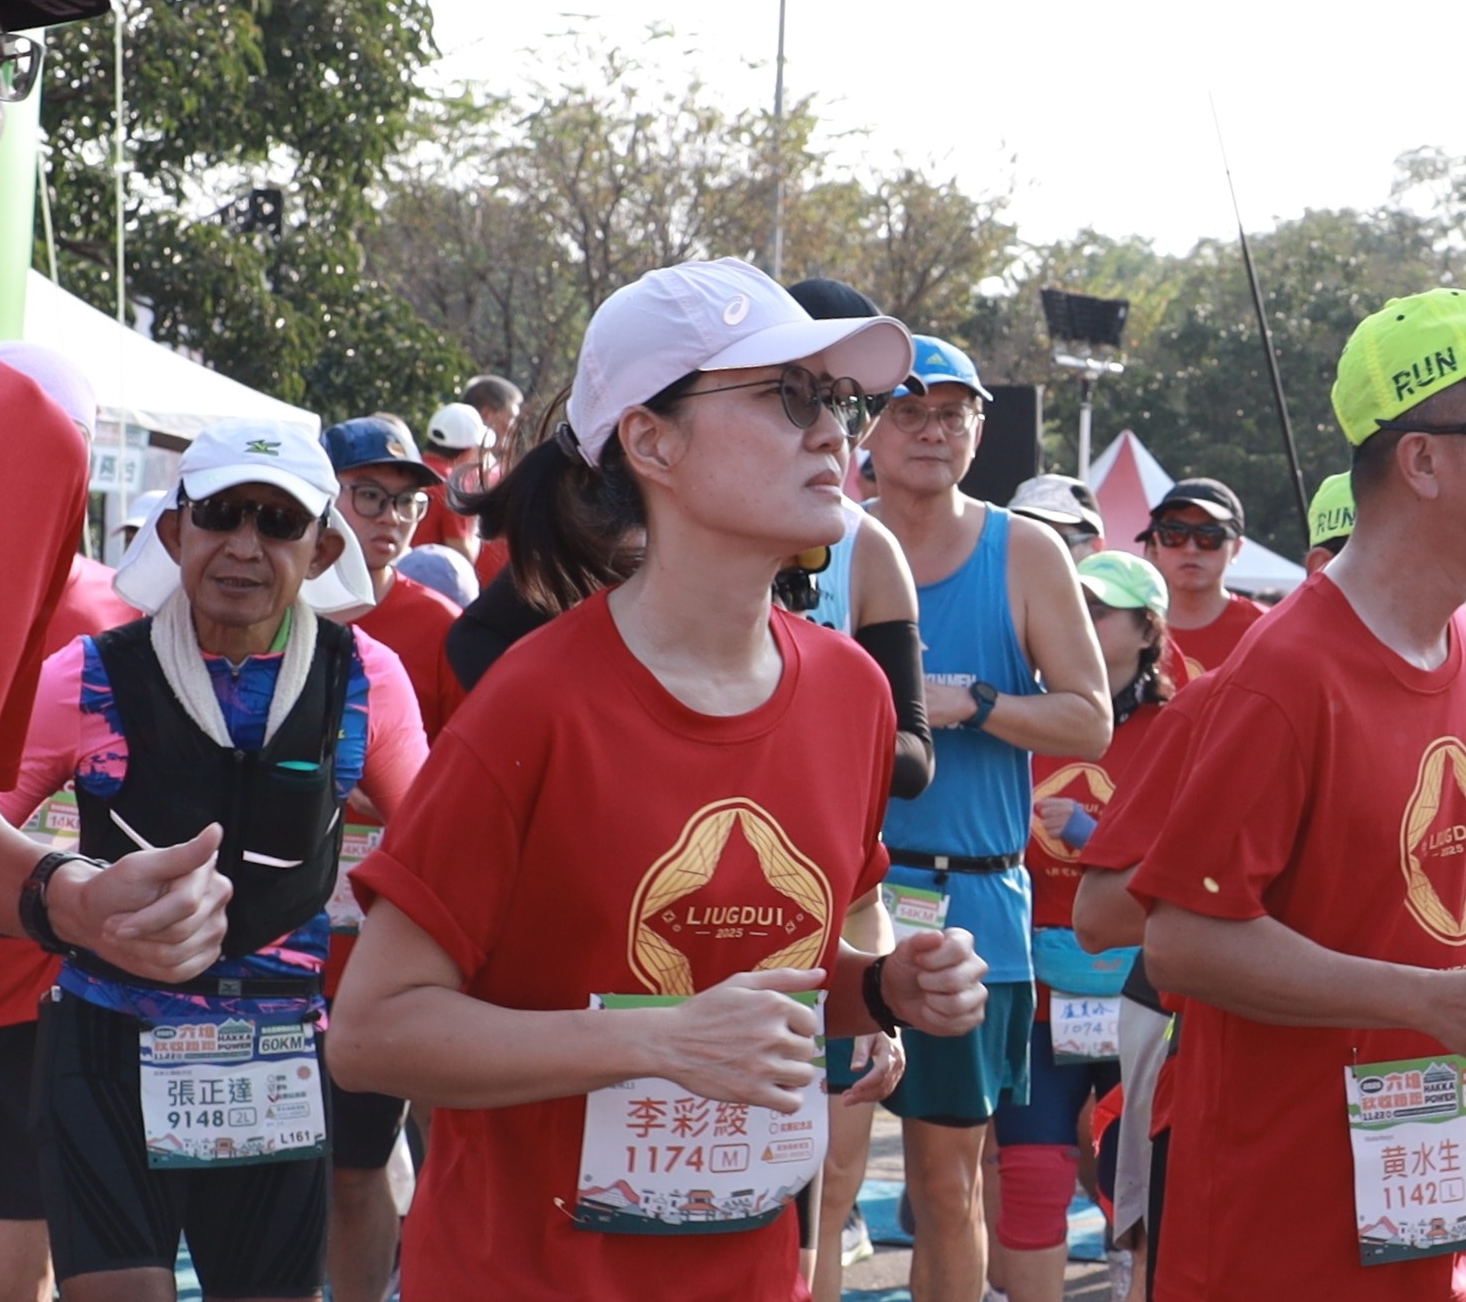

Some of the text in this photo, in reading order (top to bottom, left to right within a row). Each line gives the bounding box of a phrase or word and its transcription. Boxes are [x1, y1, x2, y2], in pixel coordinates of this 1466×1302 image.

[1392, 347, 1458, 402] RUN
[686, 905, 784, 927] LIUGDUI
[716, 927, 744, 938] 2025
[217, 1034, 251, 1042] HAKKA
[261, 1036, 302, 1051] 60KM
[167, 1077, 253, 1106] 張正達
[1424, 1082, 1455, 1092] HAKKA
[1425, 1093, 1457, 1104] POWER
[167, 1110, 224, 1129] 9148
[236, 1112, 250, 1124] 2L
[280, 1131, 311, 1144] L161
[626, 1146, 704, 1173] 1174
[722, 1151, 739, 1167] M
[1384, 1182, 1438, 1209] 1142
[1448, 1184, 1456, 1198] L
